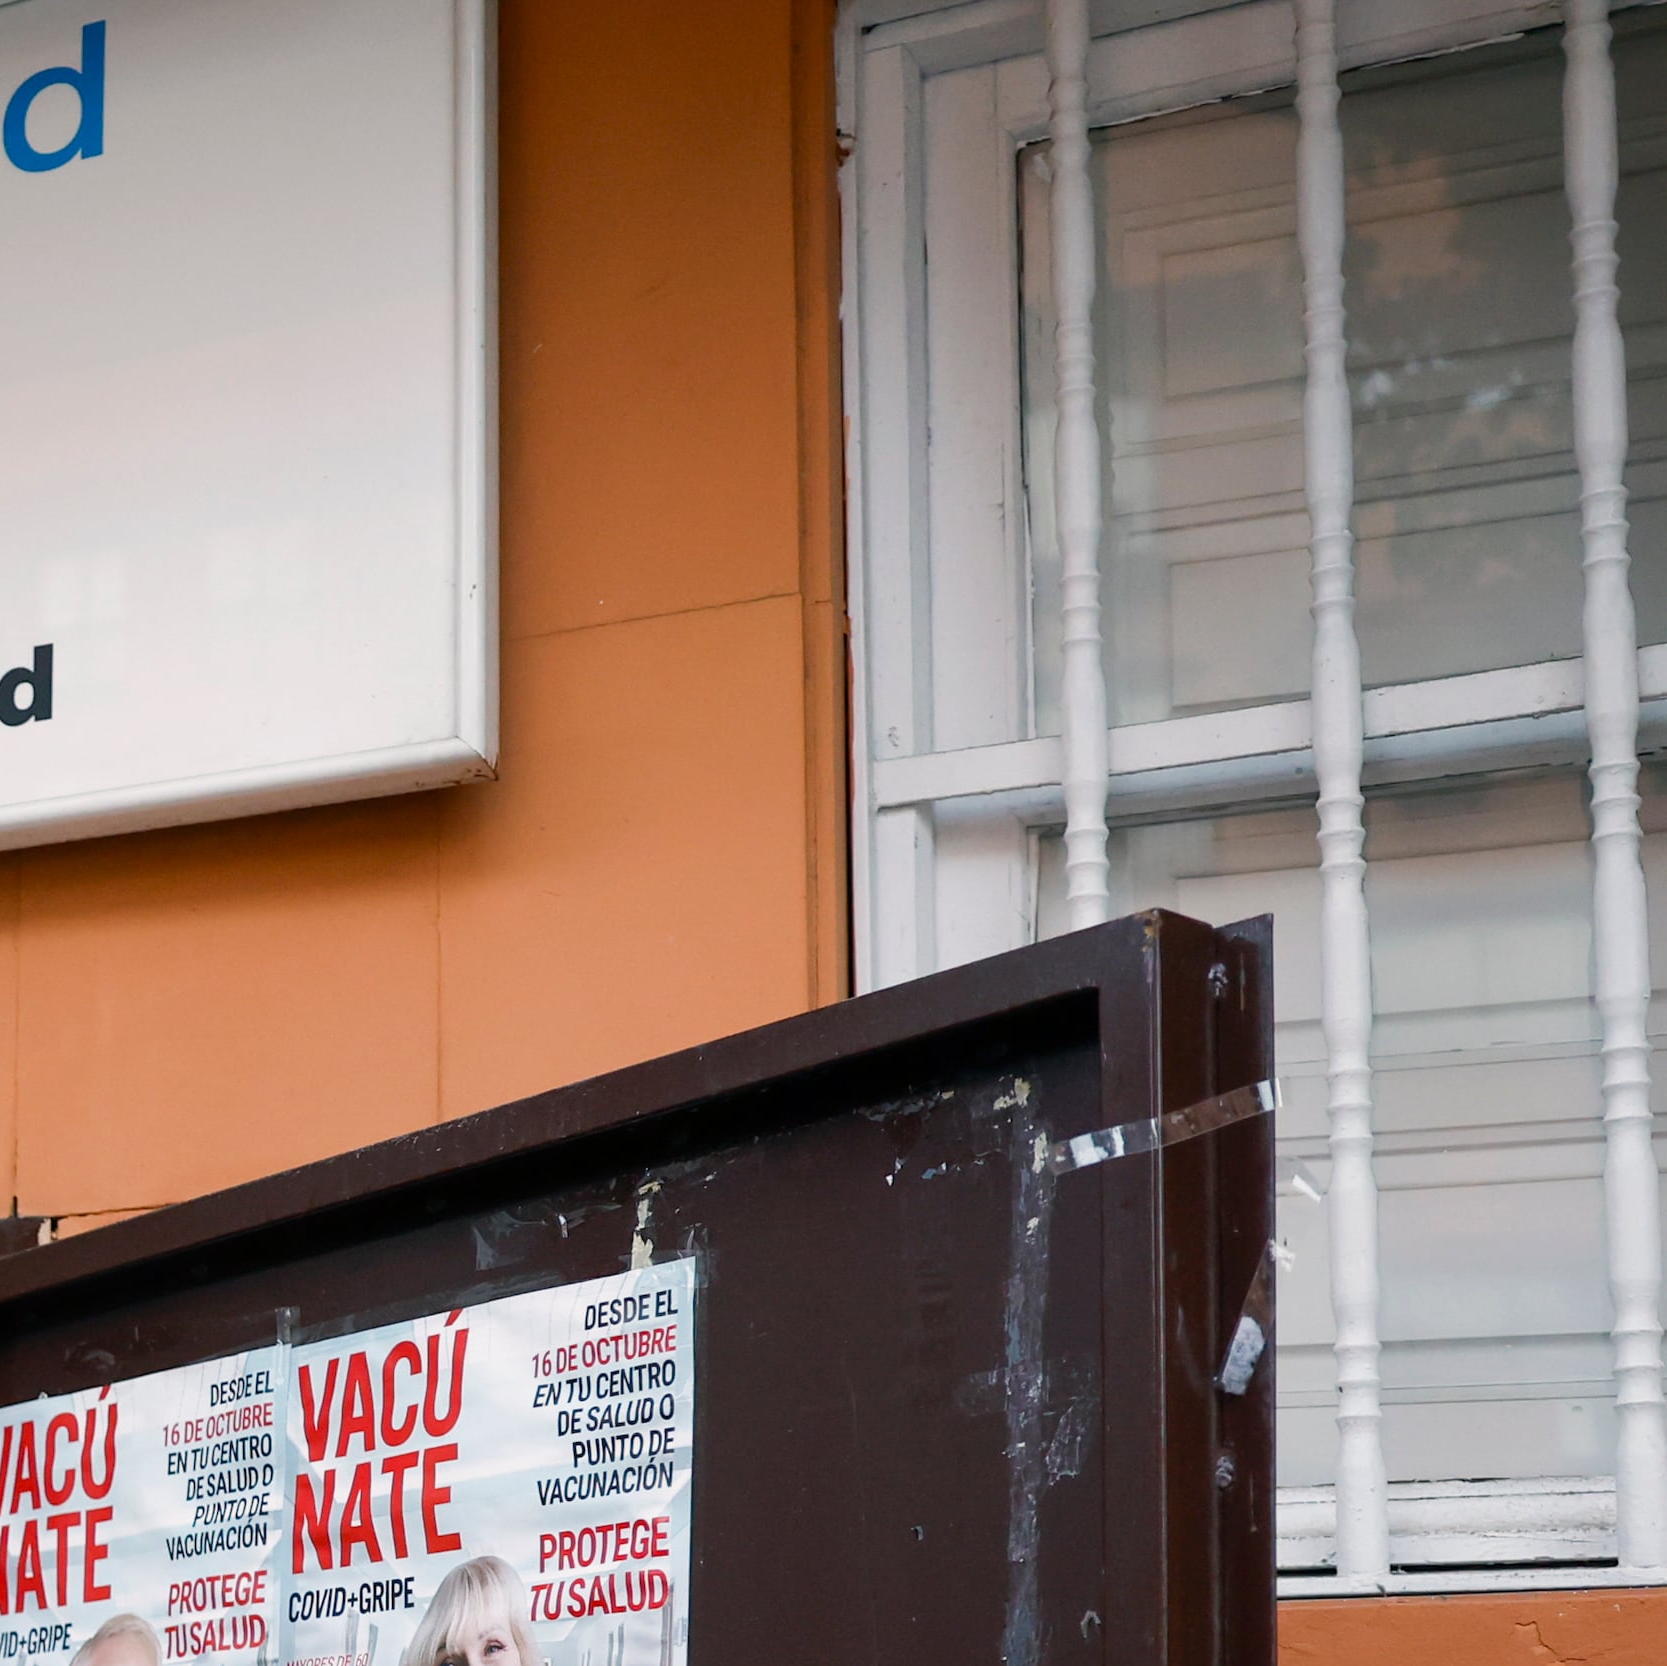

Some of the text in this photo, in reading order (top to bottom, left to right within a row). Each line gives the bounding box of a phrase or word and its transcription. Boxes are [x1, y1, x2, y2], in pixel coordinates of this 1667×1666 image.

[584, 1289, 678, 1331] DESDE EL
[532, 1324, 678, 1378] 16 DE OCTUBRE
[298, 1307, 470, 1463] VACÚ
[533, 1359, 676, 1408] EN TU CENTRO
[557, 1393, 676, 1437] DE SALUD O
[573, 1427, 676, 1468] PUNTO DE
[537, 1456, 674, 1506] VACUNACIÓN
[291, 1442, 463, 1575] NATE
[539, 1515, 670, 1574] PROTEGE
[168, 1569, 267, 1617] PROTEGE
[288, 1576, 415, 1623] COVID+GRIPE
[530, 1568, 670, 1622] TU SALUD
[164, 1613, 267, 1660] TU SALUD
